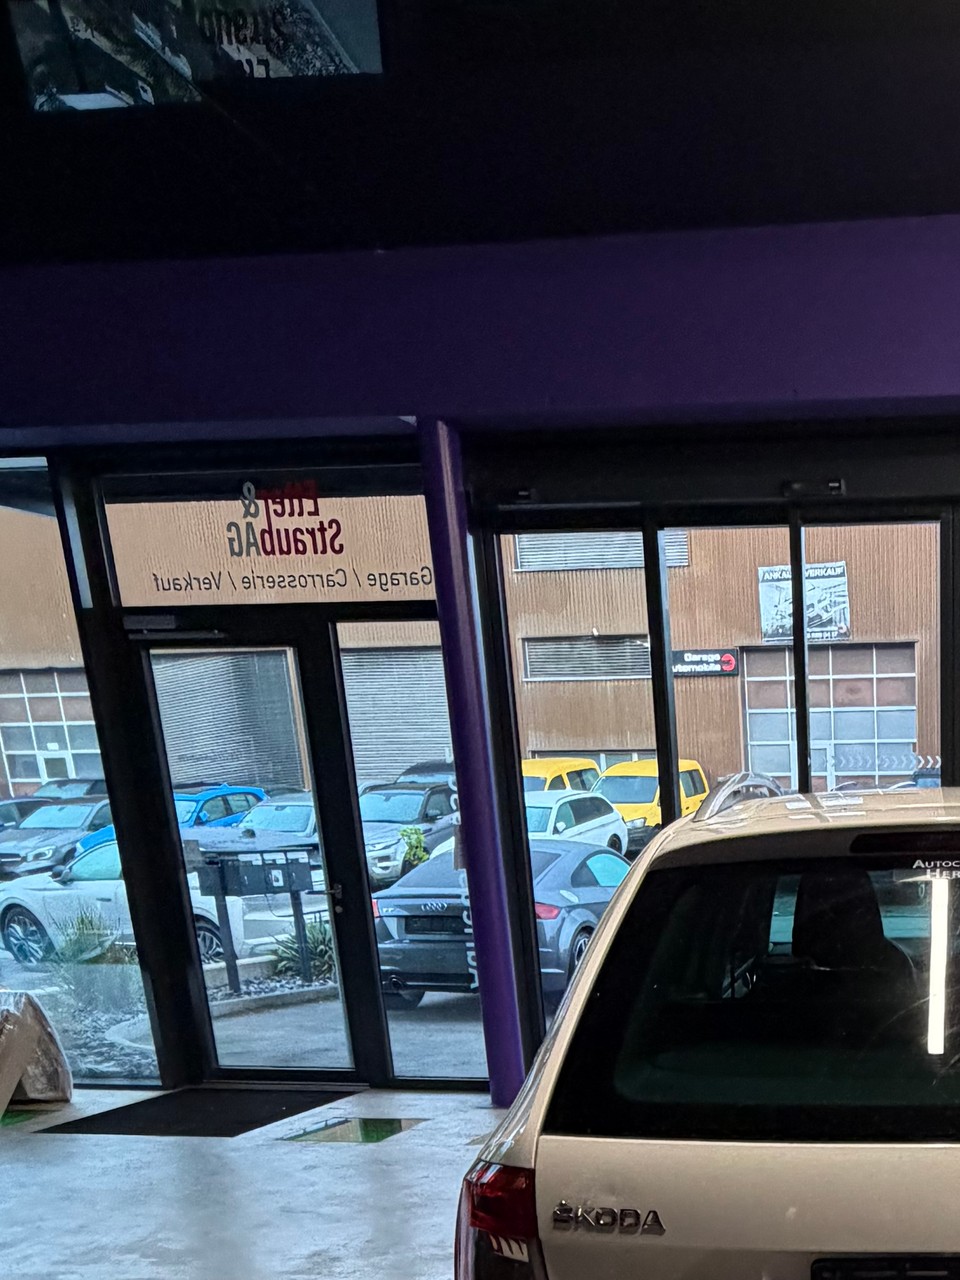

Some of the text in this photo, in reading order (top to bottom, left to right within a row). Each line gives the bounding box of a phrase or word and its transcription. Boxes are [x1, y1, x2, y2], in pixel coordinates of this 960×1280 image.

[763, 569, 792, 580] ANKA
[683, 652, 720, 662] Garage
[672, 663, 721, 672] utomobile
